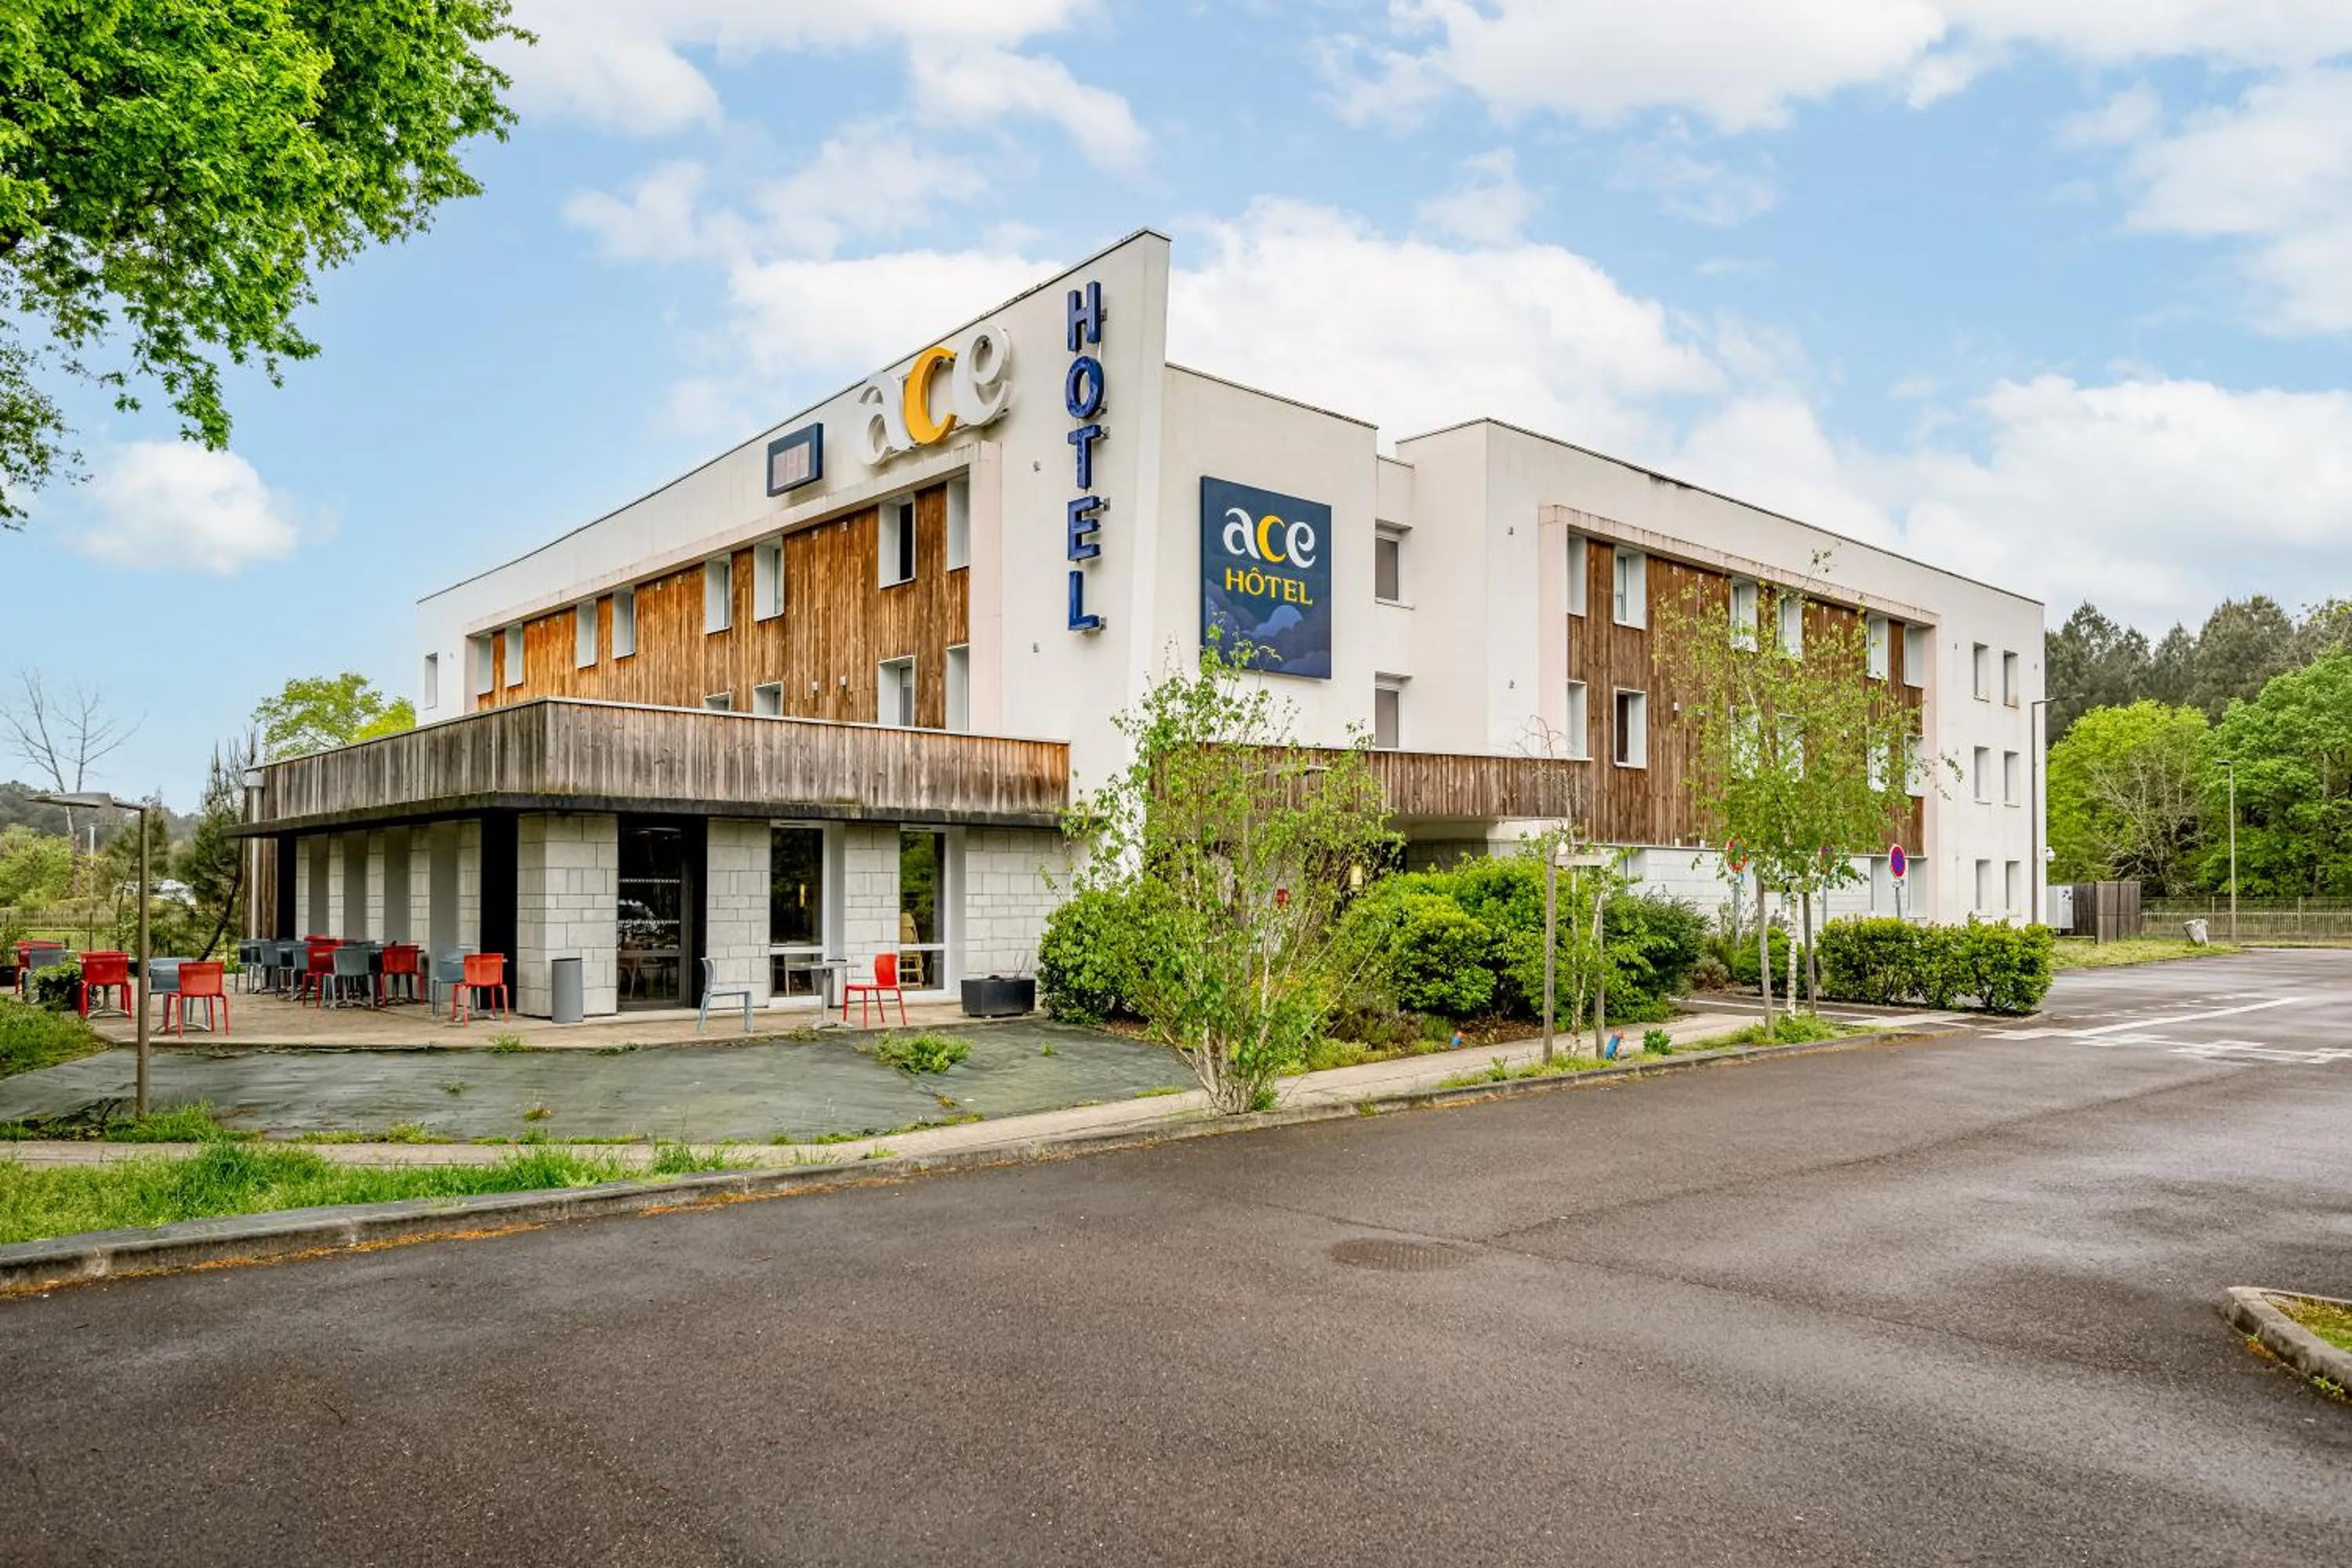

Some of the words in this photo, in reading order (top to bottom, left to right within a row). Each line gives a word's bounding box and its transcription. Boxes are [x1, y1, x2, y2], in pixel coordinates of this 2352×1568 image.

[855, 324, 1011, 465] ace
[1065, 280, 1105, 630] HOTEL
[1222, 507, 1316, 568] ace
[1225, 566, 1313, 606] HÔTEL
